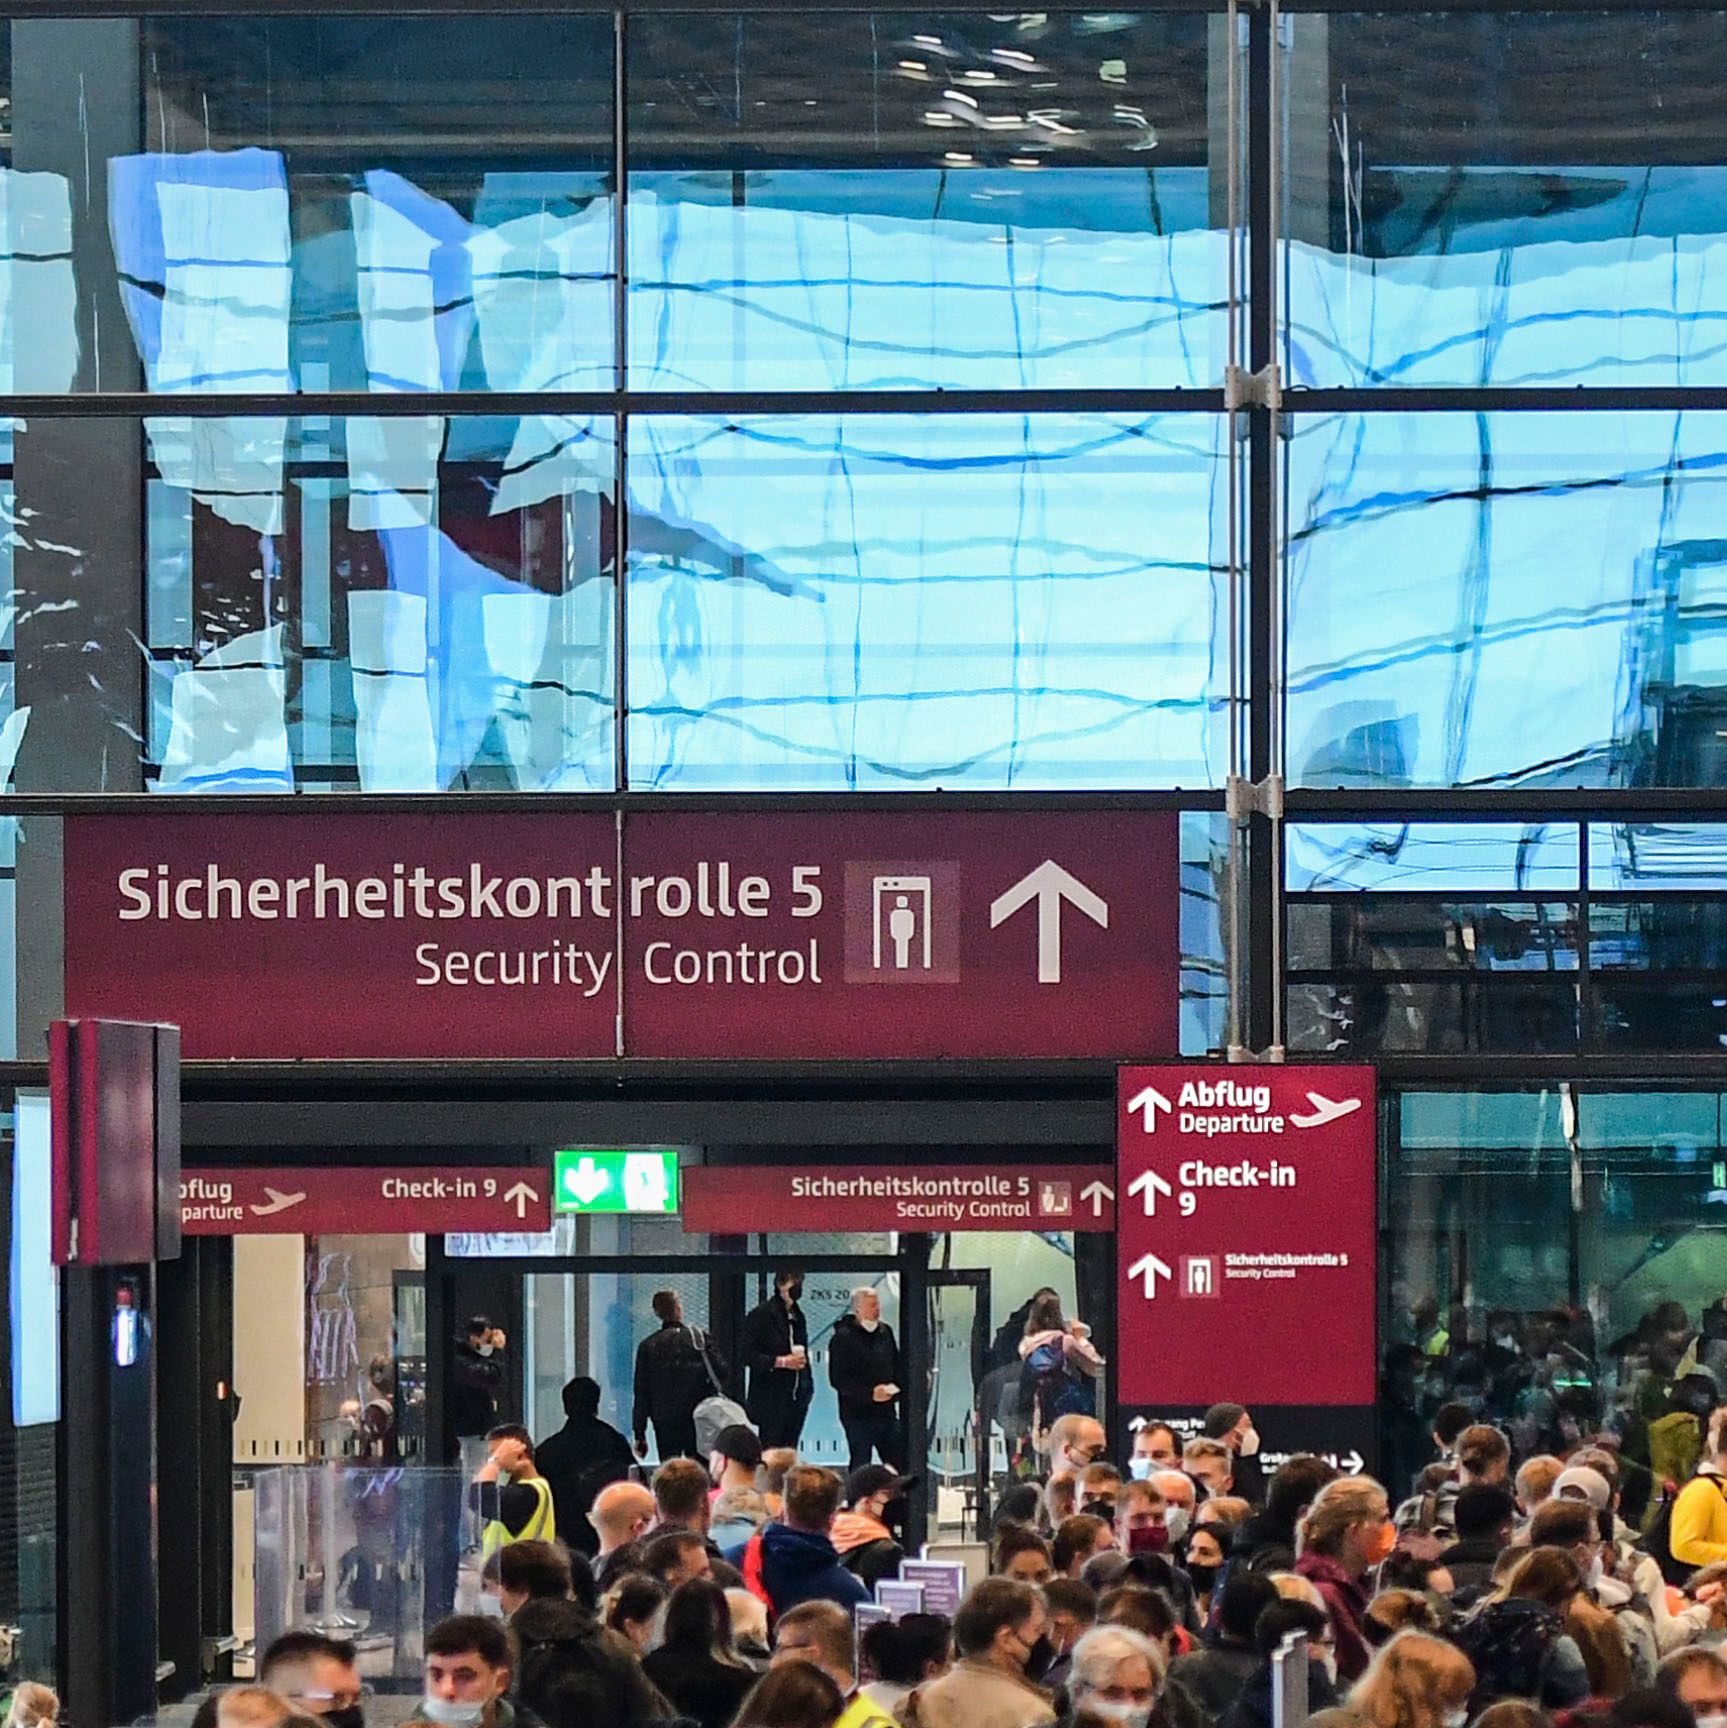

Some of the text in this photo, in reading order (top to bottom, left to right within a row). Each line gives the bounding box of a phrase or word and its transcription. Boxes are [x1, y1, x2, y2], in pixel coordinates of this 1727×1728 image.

[791, 865, 823, 918] 5
[415, 938, 823, 997] Security Control
[1178, 1081, 1271, 1113] Abflug
[1179, 1112, 1285, 1138] Departure
[1178, 1160, 1297, 1187] Check-in
[381, 1178, 497, 1199] Check-in 9
[791, 1175, 1031, 1198] Sicherheitskontrolle 5
[181, 1203, 243, 1223] parture
[896, 1200, 1031, 1221] Security Control
[1178, 1191, 1197, 1217] 9
[1225, 1254, 1339, 1266] Sicherheitskontrolle
[1263, 1268, 1296, 1279] Control
